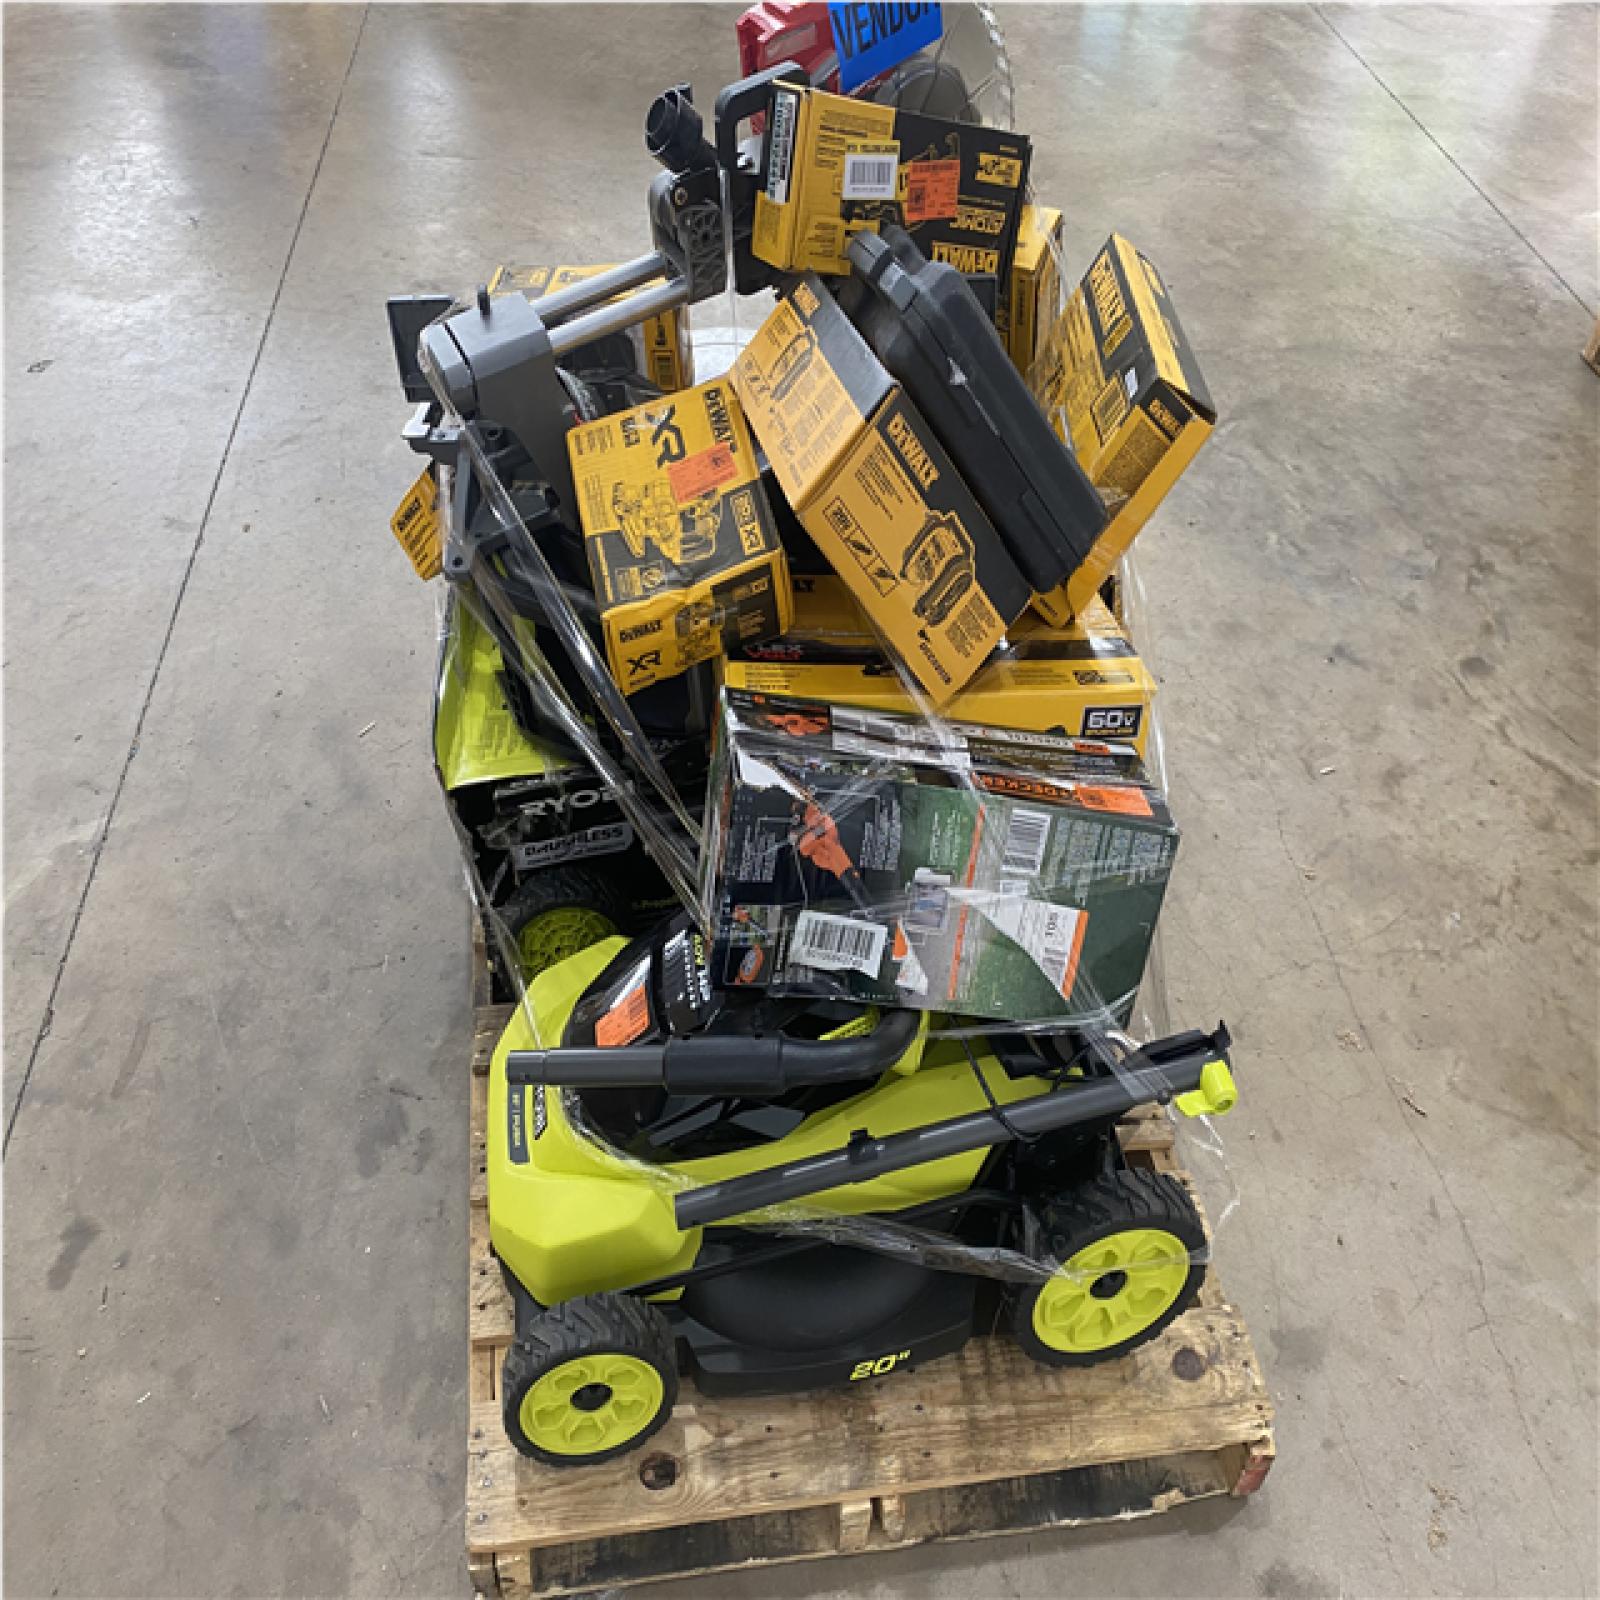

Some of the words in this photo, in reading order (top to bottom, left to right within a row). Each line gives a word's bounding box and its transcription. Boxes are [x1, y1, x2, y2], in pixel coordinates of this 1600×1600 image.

[645, 404, 687, 469] XR
[886, 412, 942, 485] DEWALT
[619, 619, 663, 642] DEWALT
[626, 651, 662, 674] XR
[1088, 710, 1135, 728] 60V
